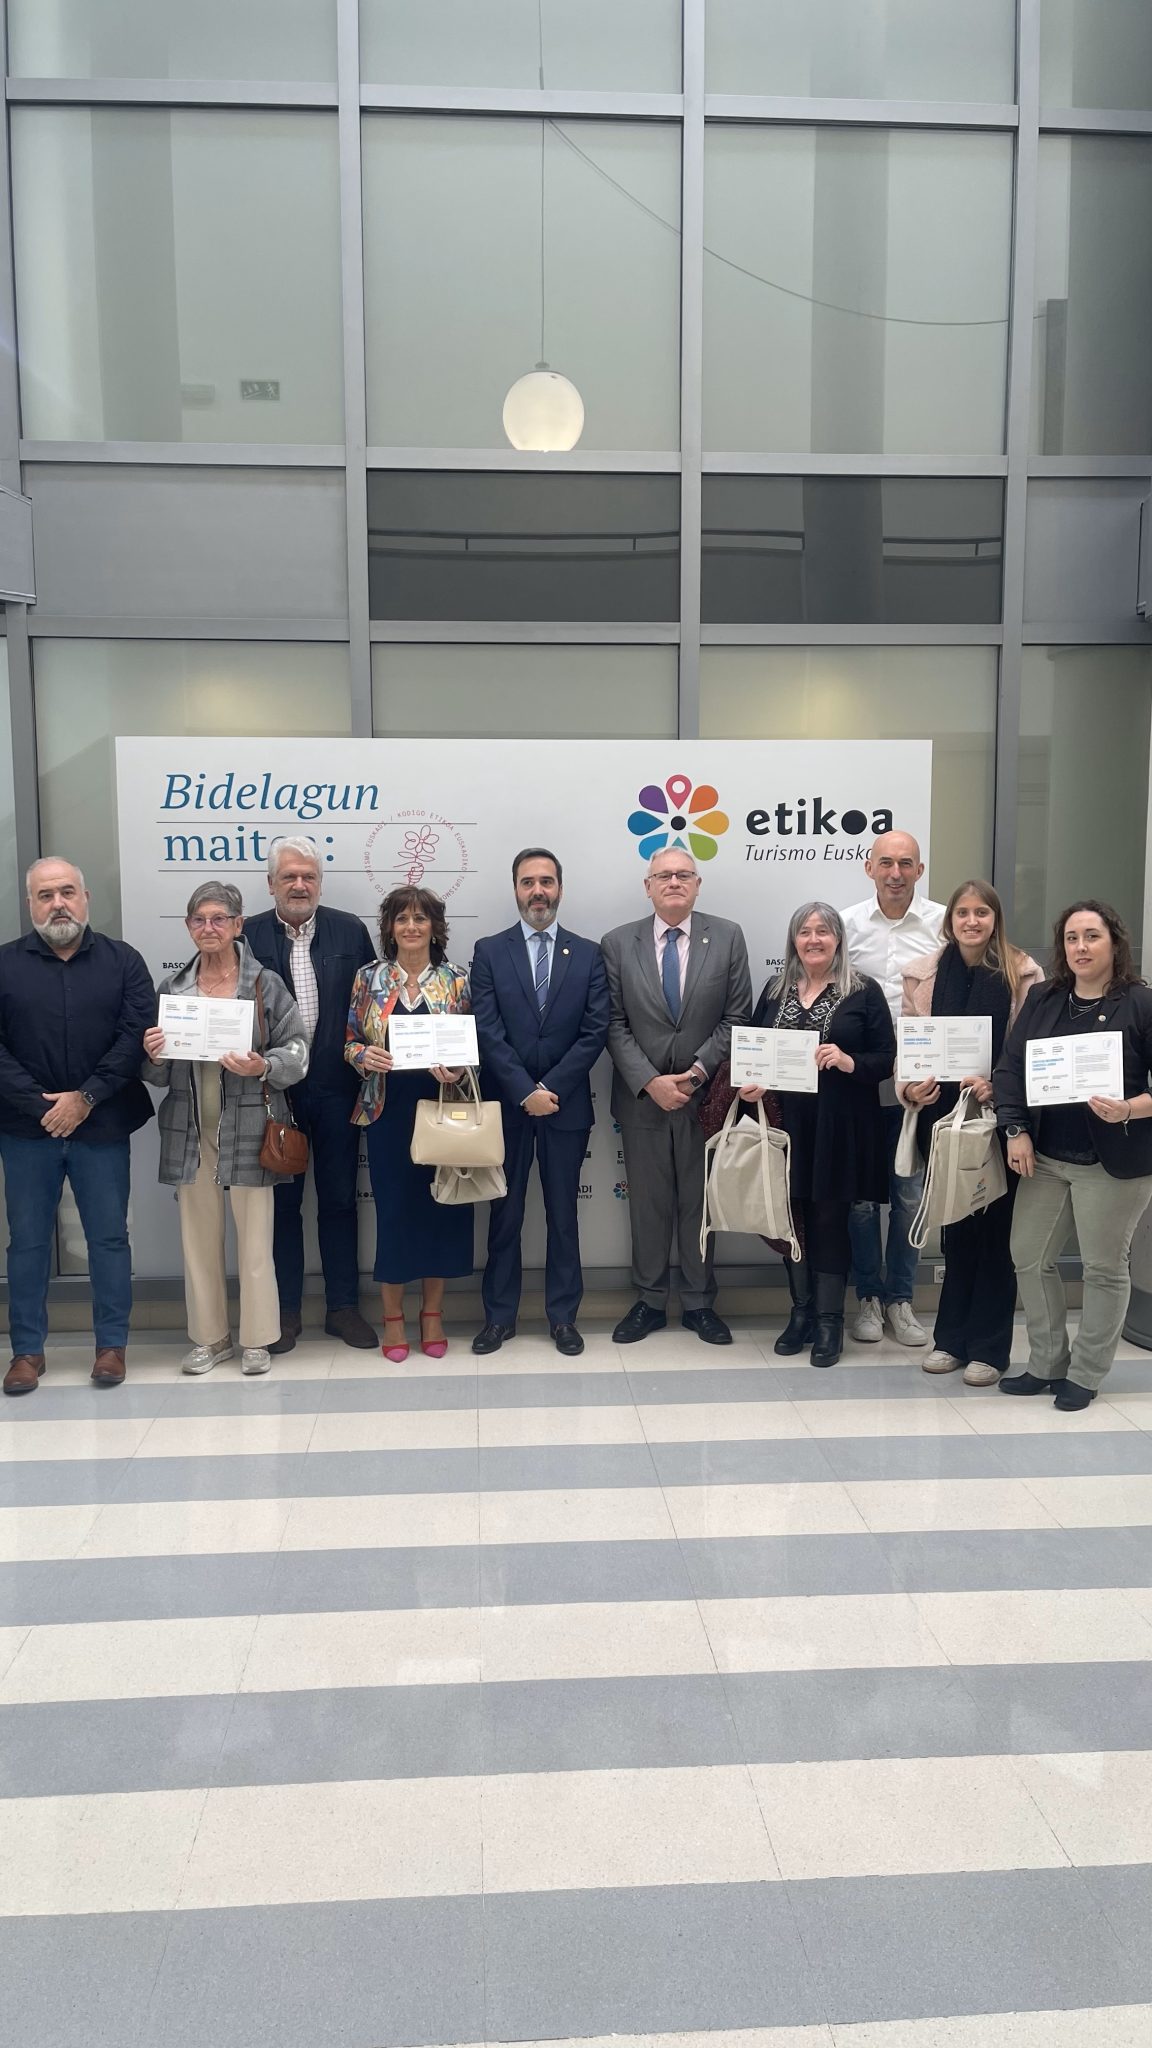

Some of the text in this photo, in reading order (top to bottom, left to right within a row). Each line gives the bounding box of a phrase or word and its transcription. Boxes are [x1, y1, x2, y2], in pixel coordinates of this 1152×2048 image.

[160, 772, 379, 819] Bidelagun
[746, 796, 894, 836] etikoa
[163, 826, 335, 862] mait:
[745, 844, 873, 861] Turismo Eusk
